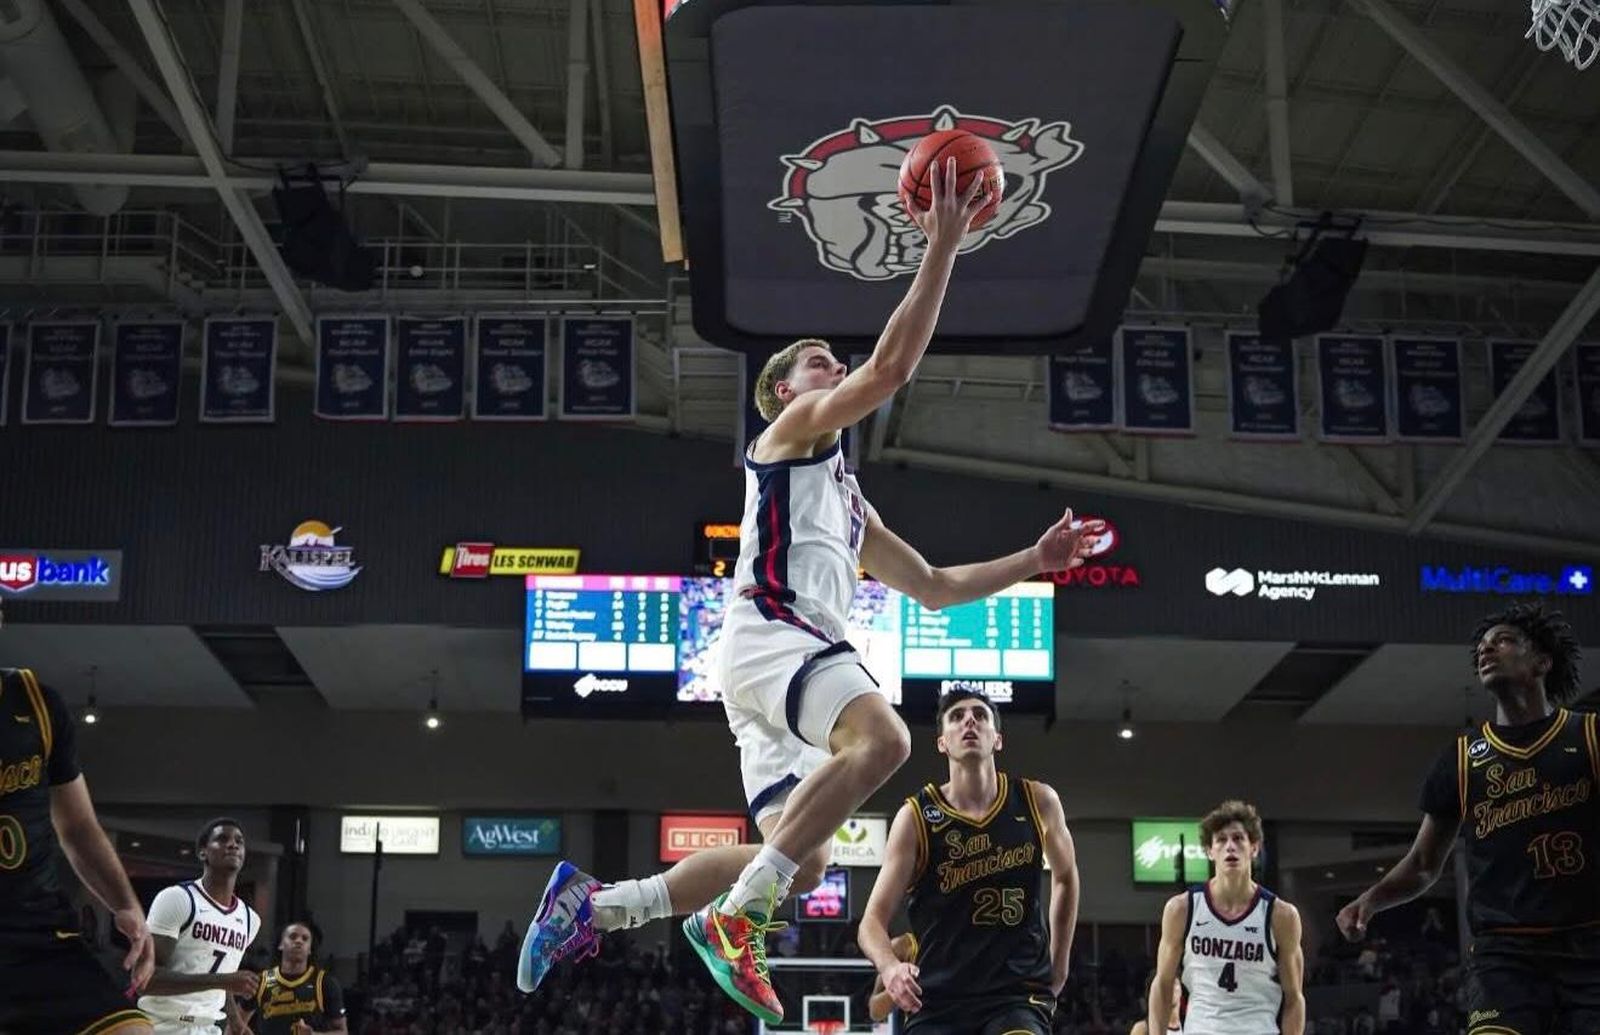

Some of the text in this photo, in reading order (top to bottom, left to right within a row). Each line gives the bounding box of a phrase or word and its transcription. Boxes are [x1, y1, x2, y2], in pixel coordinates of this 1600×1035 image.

[0, 556, 109, 584] us bank
[493, 555, 575, 568] LES SCHWAB
[713, 560, 726, 577] 2
[1041, 565, 1140, 586] OYOTA
[1257, 570, 1380, 586] MarshMcLennan
[1421, 565, 1552, 591] MultiCare
[1257, 585, 1316, 600] Agency
[1485, 764, 1537, 799] San
[1473, 778, 1591, 840] Francisco
[469, 825, 540, 850] AgWest
[674, 834, 734, 846] BECU
[945, 829, 992, 860] San
[833, 846, 876, 857] ERICA
[1527, 831, 1585, 880] 13
[937, 841, 1036, 894] Francisco
[971, 887, 1025, 926] 25
[208, 949, 227, 974] 7
[1190, 935, 1264, 962] GONZAGA
[1217, 962, 1238, 993] 4
